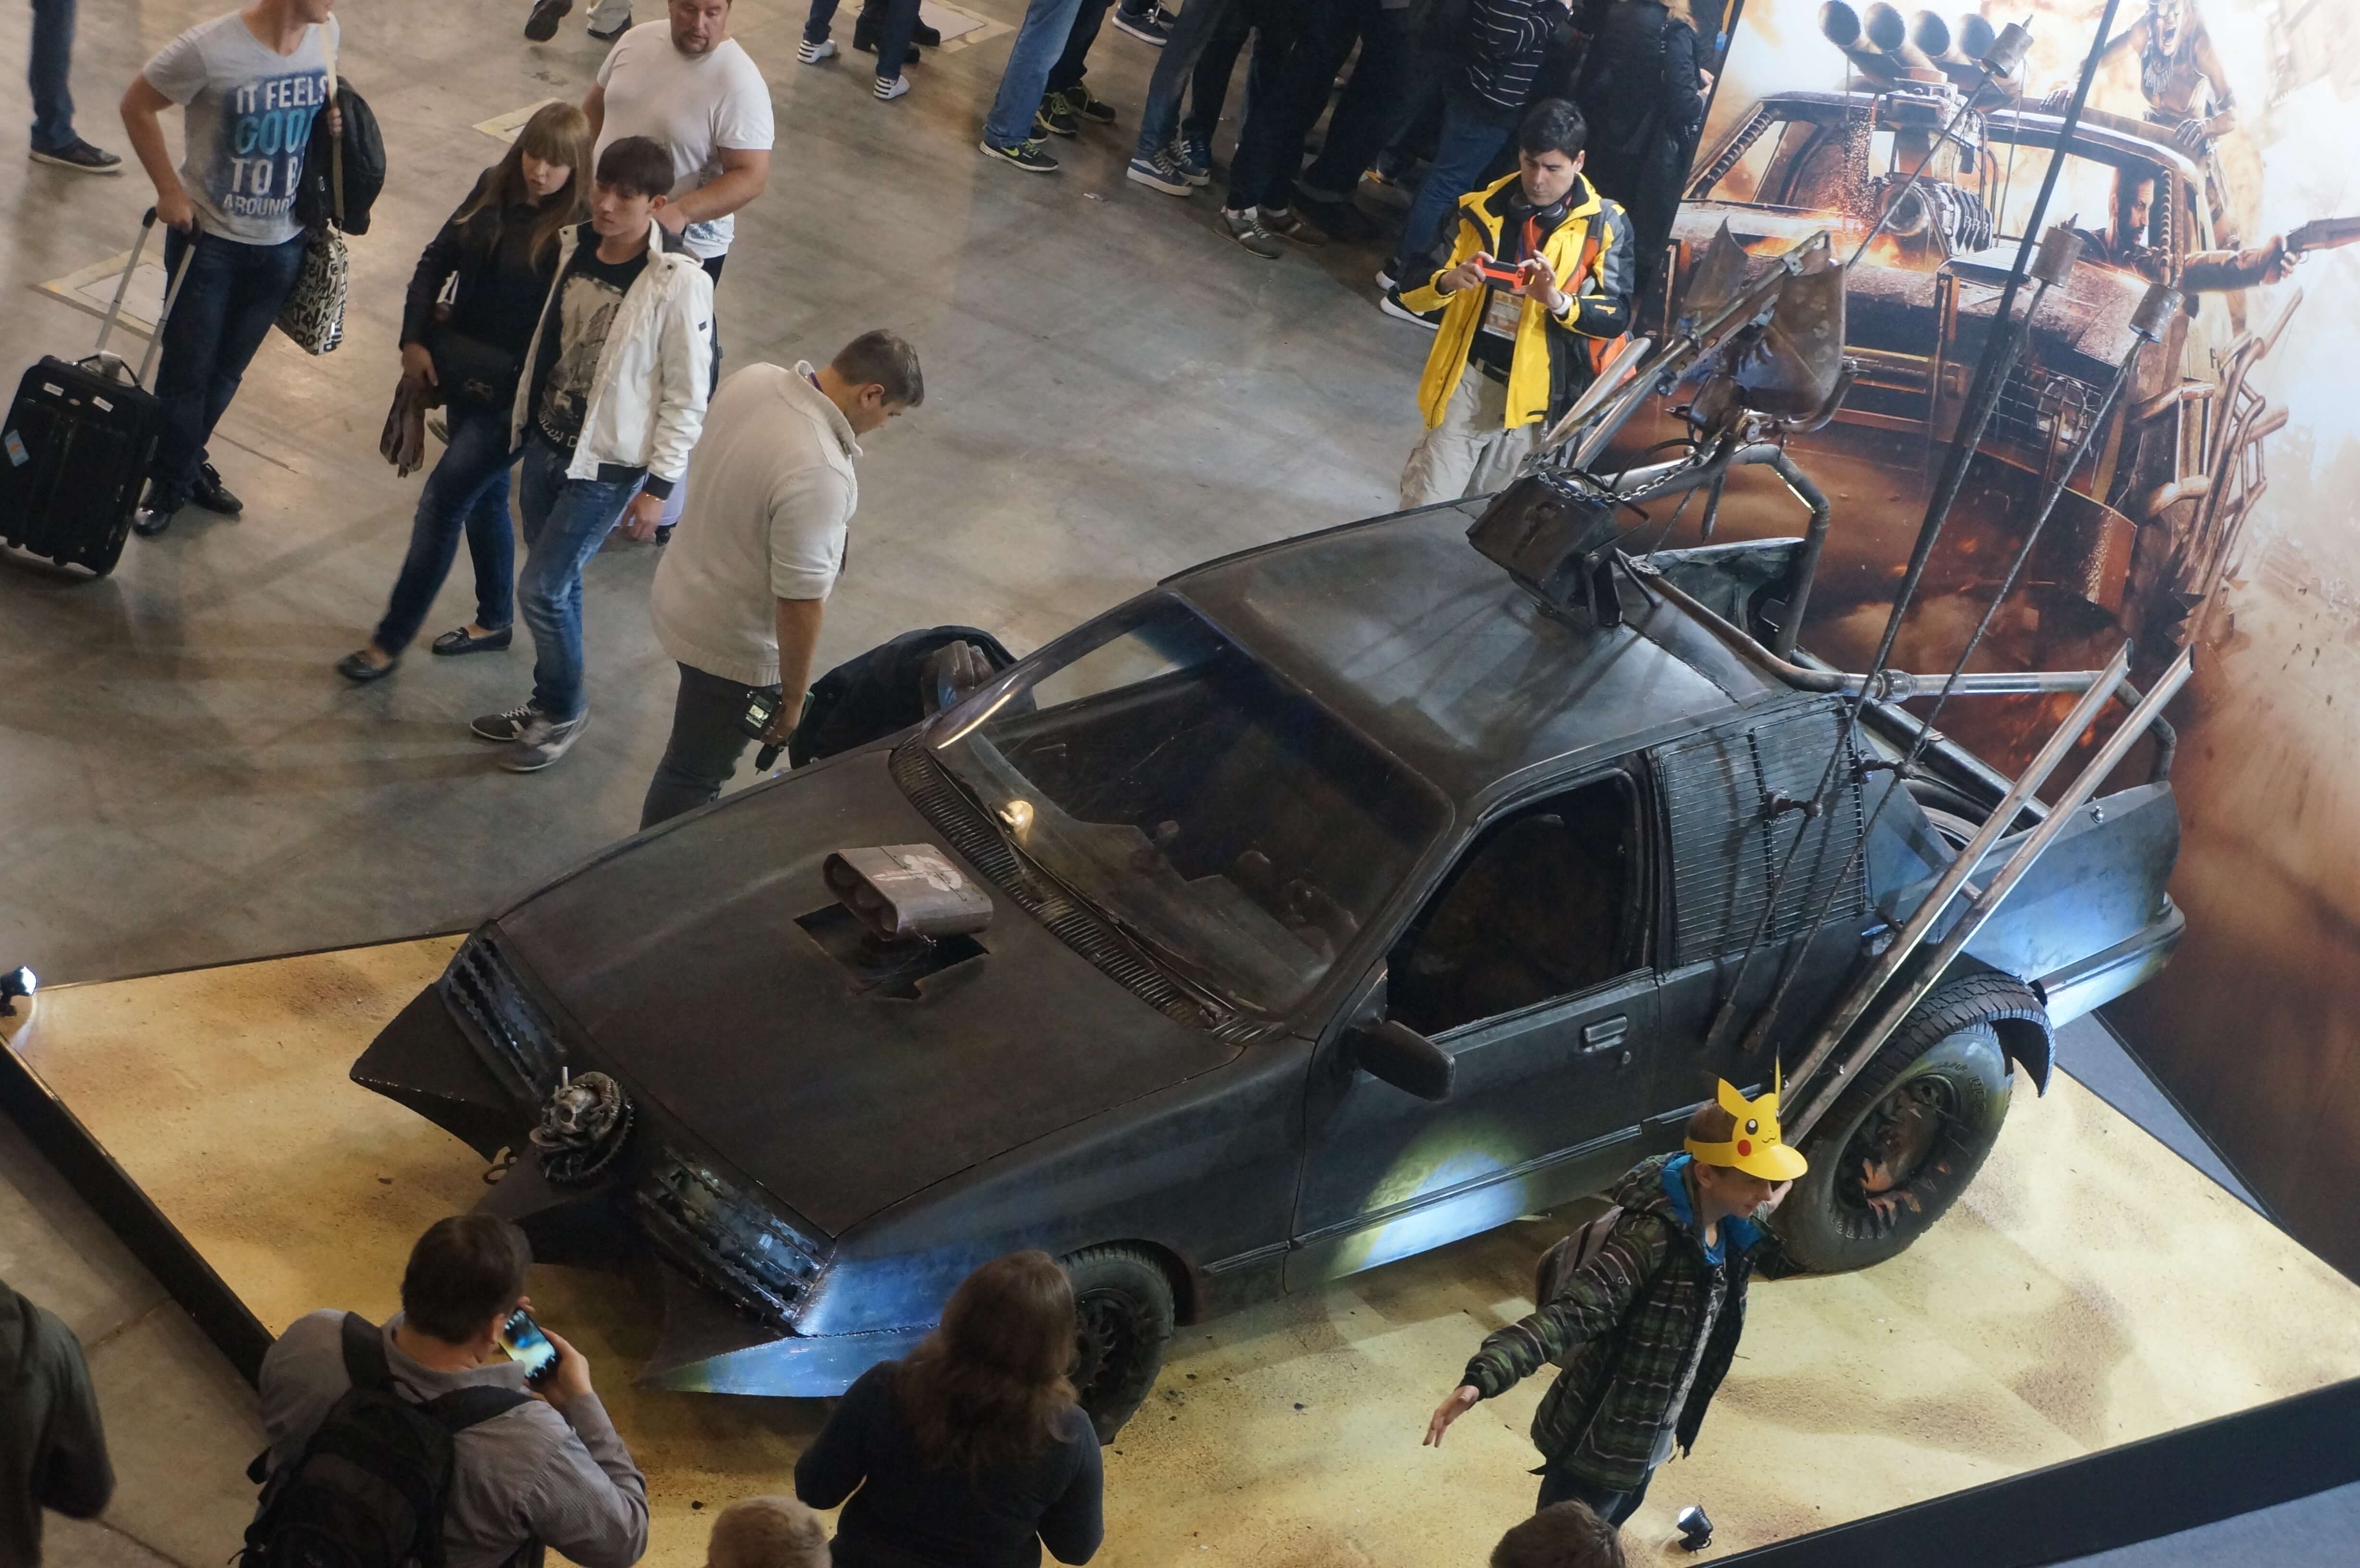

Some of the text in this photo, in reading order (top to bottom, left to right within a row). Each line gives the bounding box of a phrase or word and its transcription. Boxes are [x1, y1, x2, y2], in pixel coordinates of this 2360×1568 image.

[237, 75, 328, 114] IT FEELS
[231, 154, 304, 196] TO B
